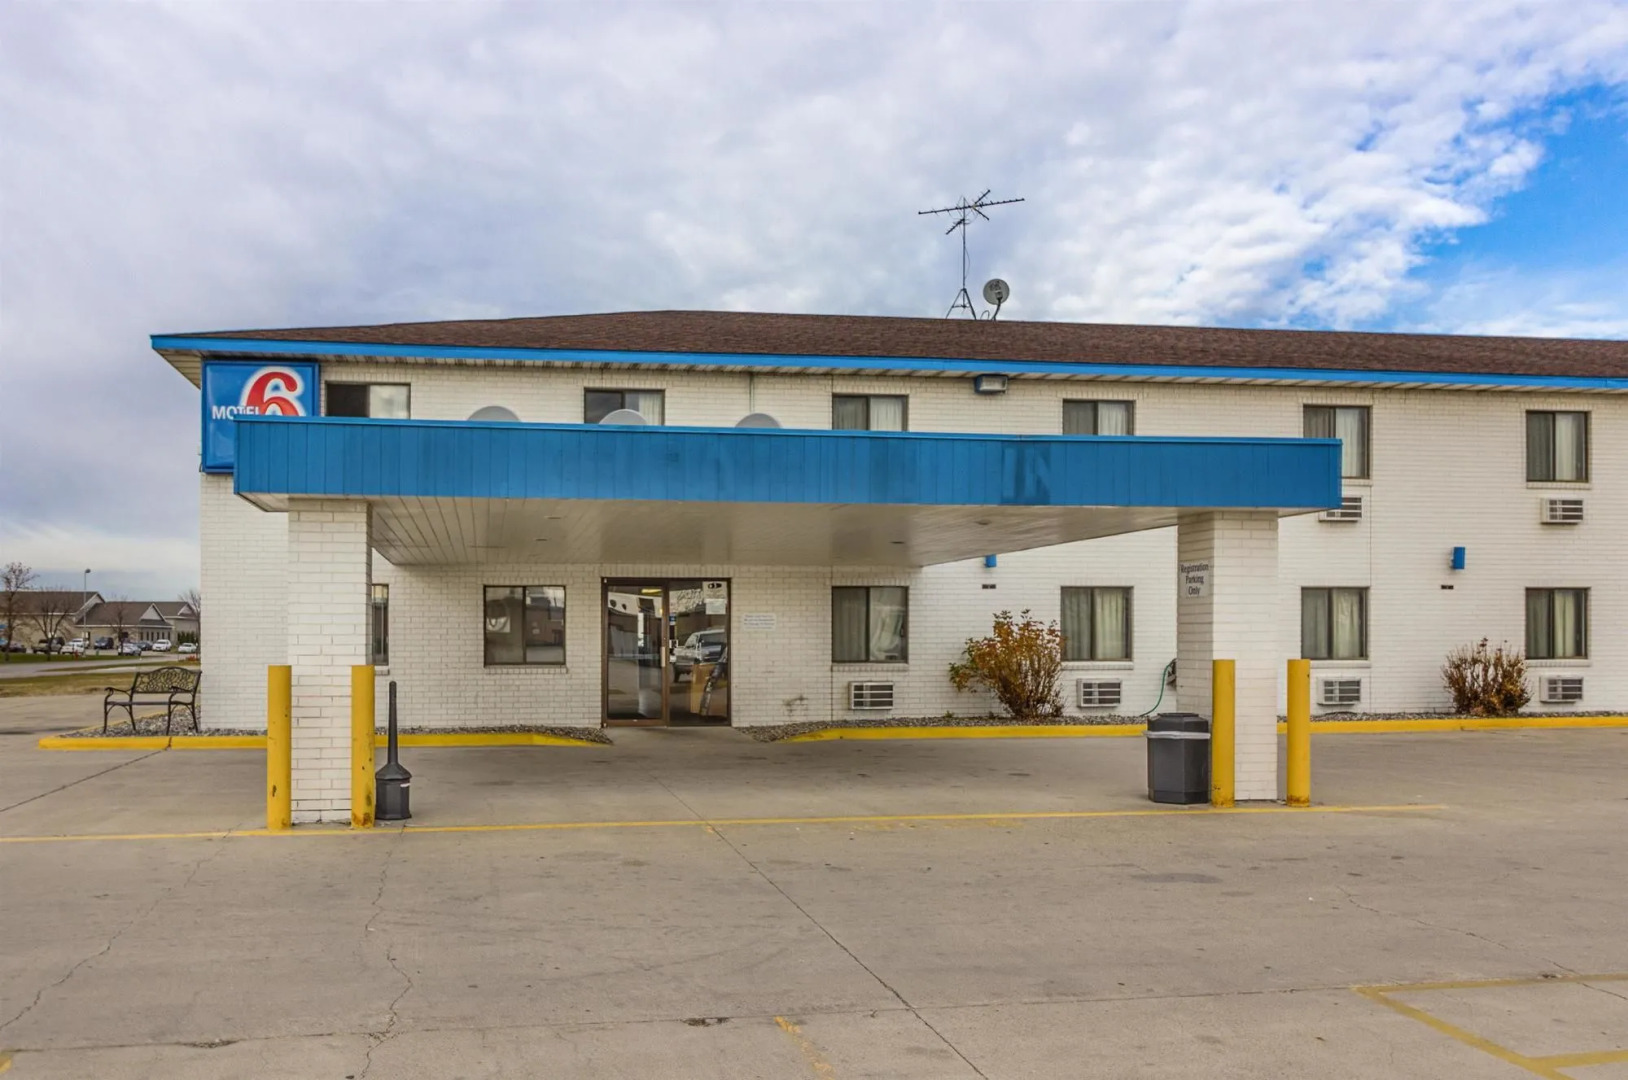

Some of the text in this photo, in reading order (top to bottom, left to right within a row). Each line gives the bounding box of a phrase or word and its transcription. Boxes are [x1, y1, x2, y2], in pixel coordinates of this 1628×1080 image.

[242, 368, 303, 416] 6
[1185, 575, 1204, 585] Parking
[1188, 586, 1200, 595] Only
